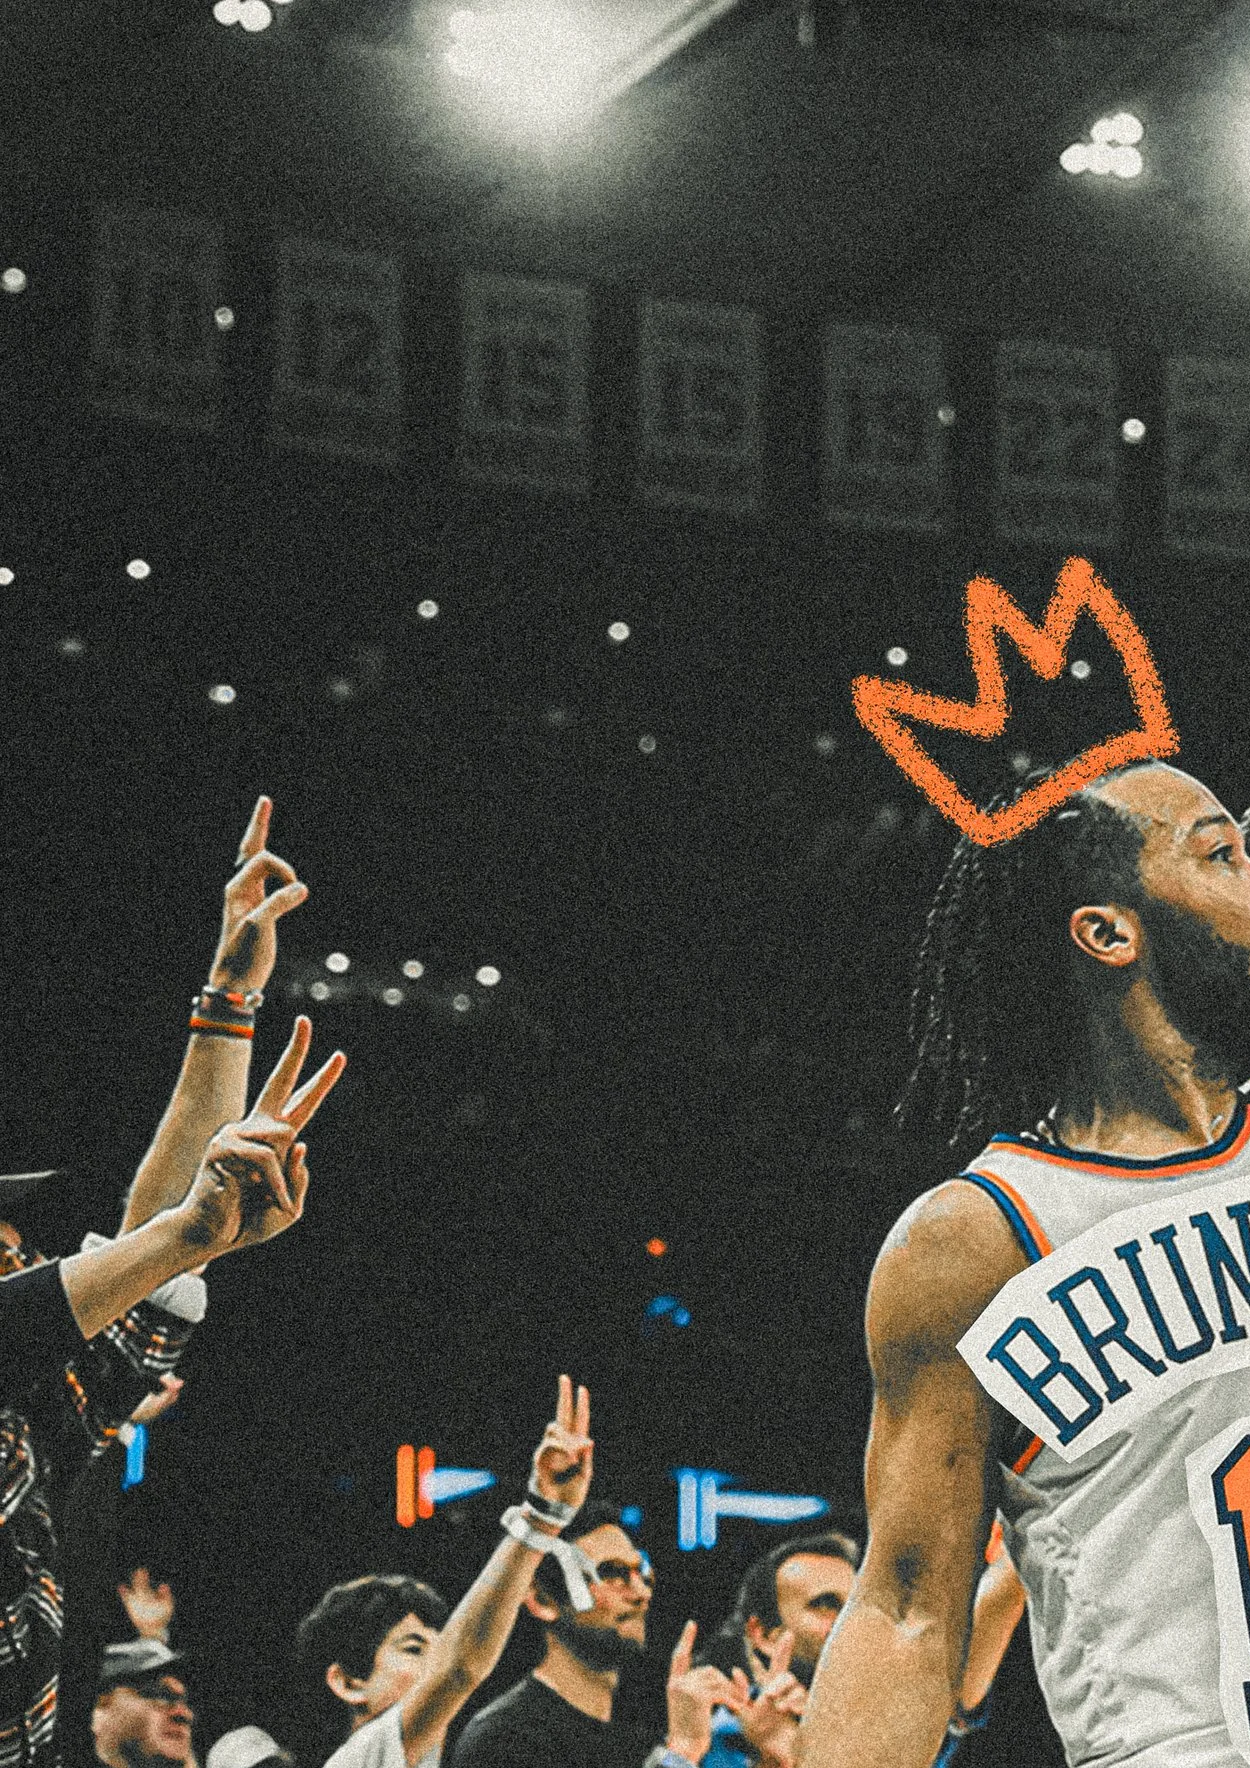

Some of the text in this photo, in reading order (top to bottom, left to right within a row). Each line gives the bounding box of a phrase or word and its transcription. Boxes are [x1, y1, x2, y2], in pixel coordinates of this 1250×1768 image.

[297, 298, 382, 402] 12
[483, 336, 567, 425] 15
[659, 361, 745, 445] 15
[1004, 401, 1105, 484] 22
